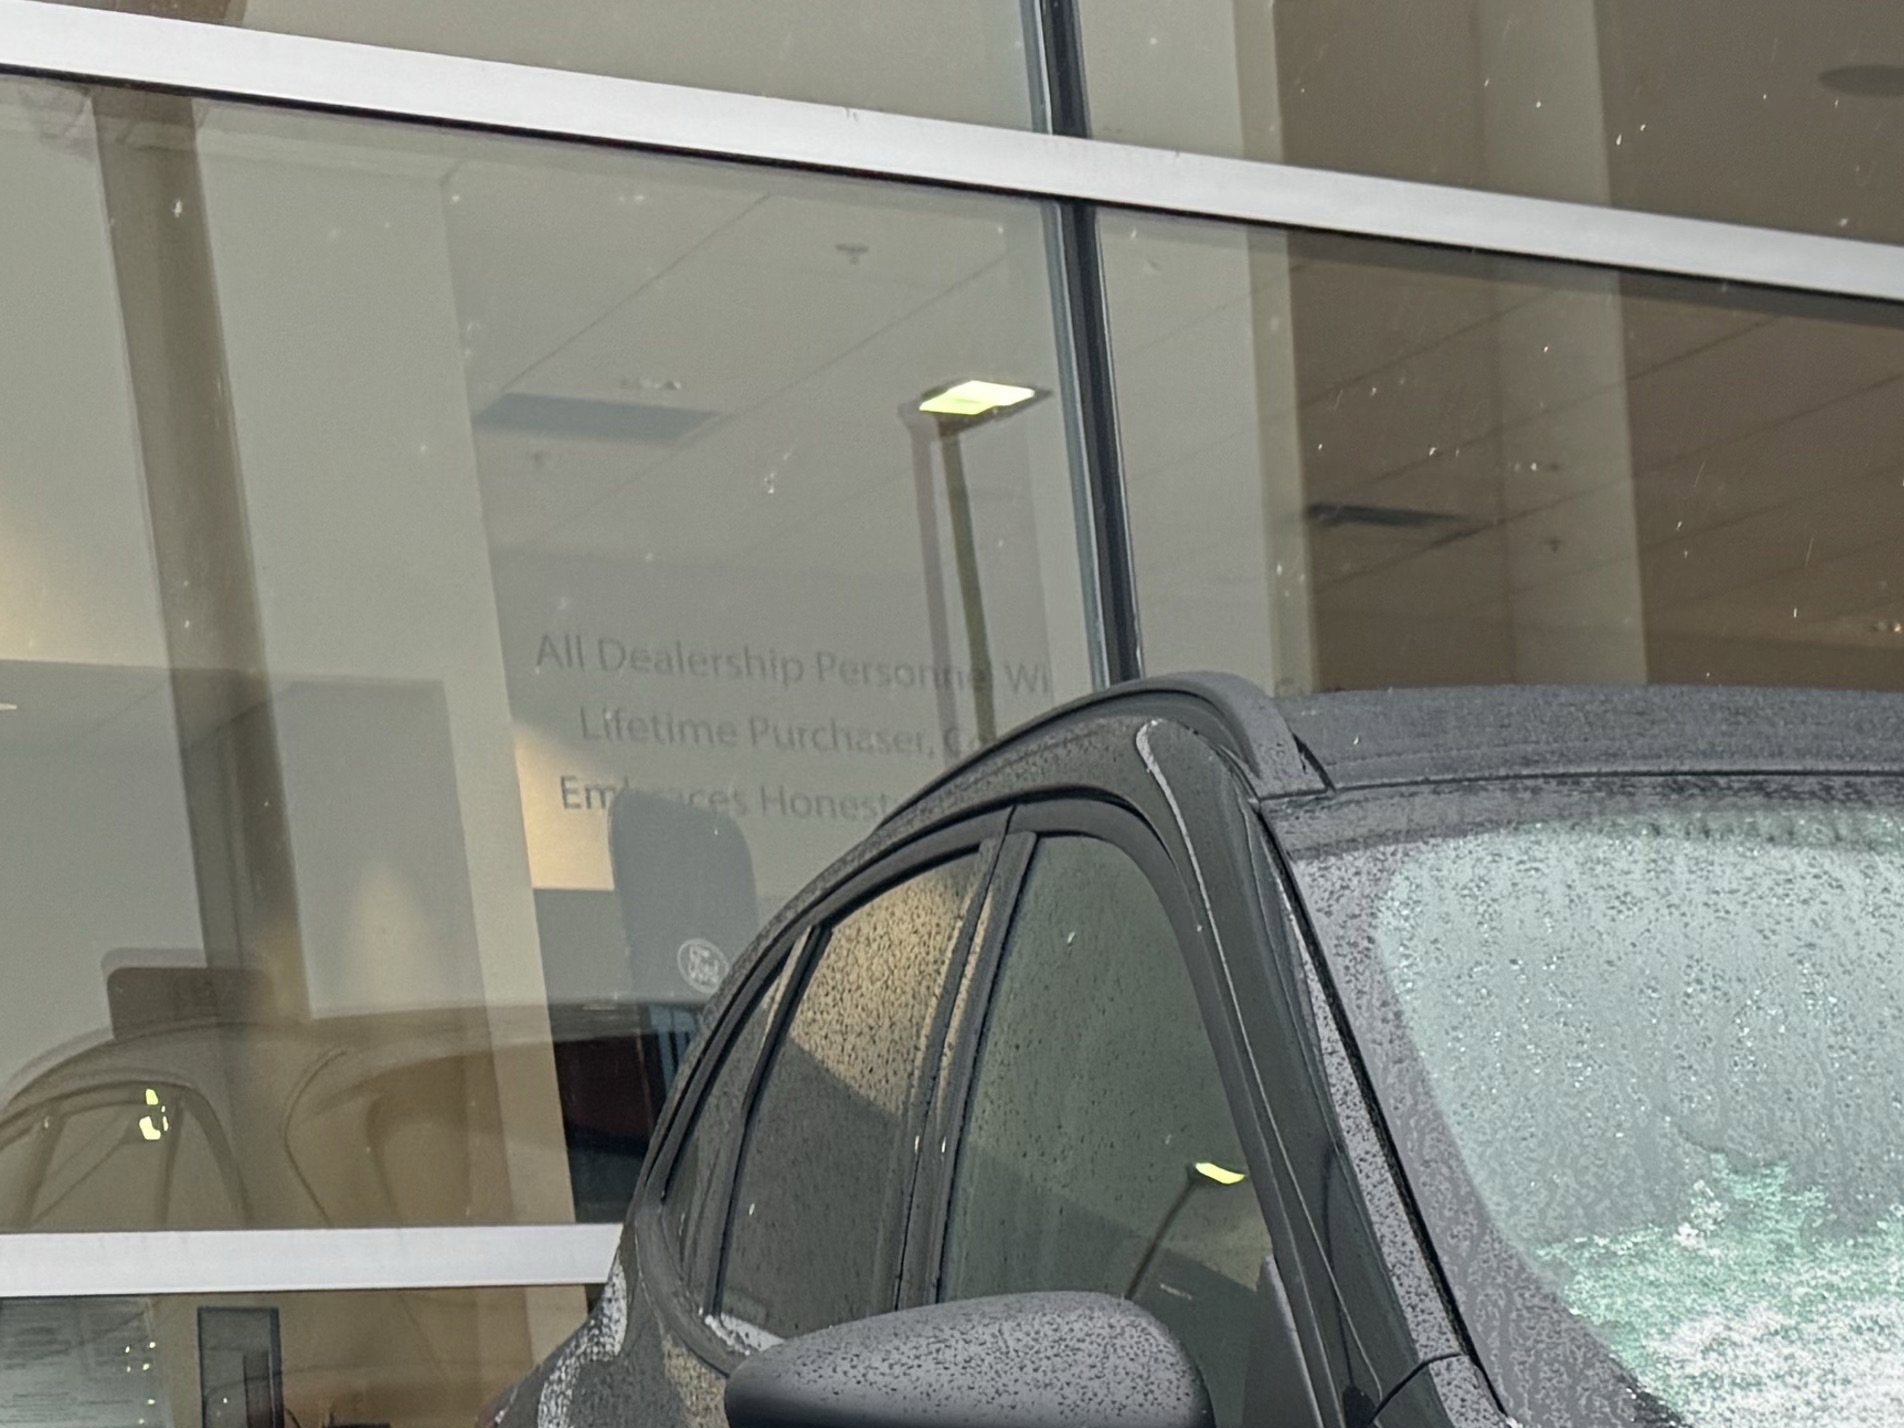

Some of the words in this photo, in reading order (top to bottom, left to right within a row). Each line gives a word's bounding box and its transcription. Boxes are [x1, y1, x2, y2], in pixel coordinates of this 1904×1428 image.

[536, 633, 585, 671] All
[597, 636, 805, 688] Dealership
[579, 705, 738, 746] Lifetime
[750, 714, 936, 760] Purchaser,
